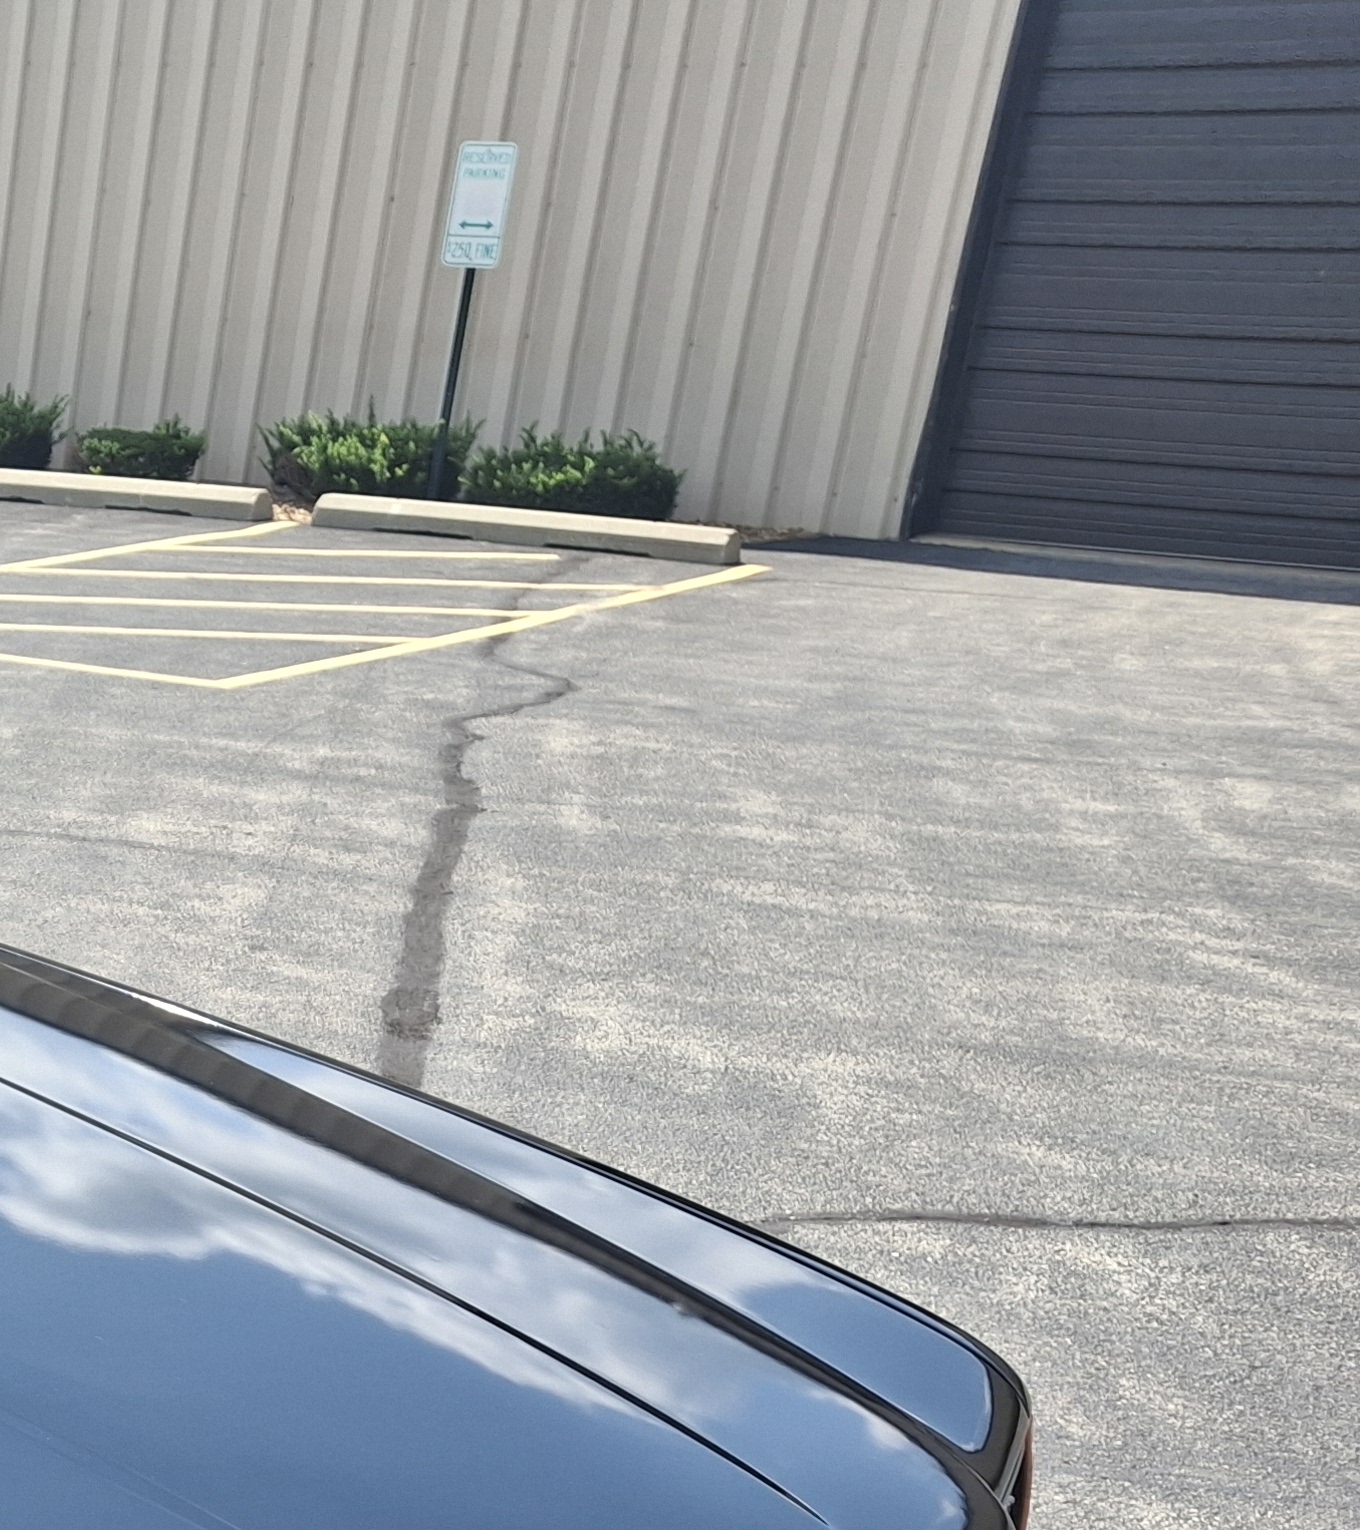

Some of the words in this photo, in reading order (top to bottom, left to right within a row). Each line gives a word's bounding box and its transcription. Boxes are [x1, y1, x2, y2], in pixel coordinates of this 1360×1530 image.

[462, 151, 512, 165] RESERVED
[462, 167, 506, 179] PARKING
[474, 242, 498, 260] FINE
